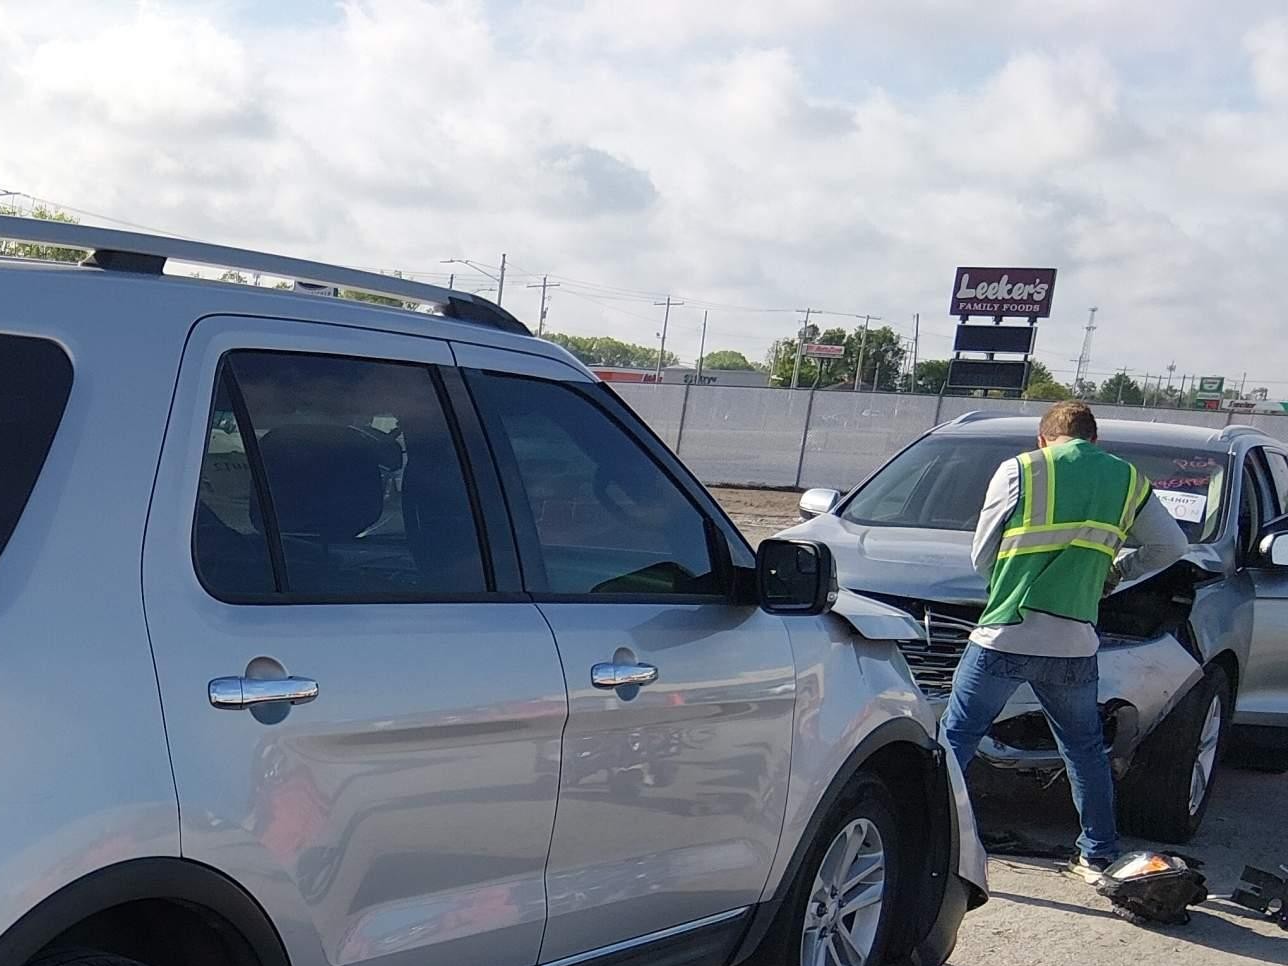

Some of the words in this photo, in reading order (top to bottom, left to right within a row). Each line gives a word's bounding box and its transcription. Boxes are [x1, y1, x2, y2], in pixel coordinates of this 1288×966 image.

[956, 273, 1049, 301] Leeker's
[959, 302, 1000, 311] FAMILY
[1002, 303, 1040, 312] FOODS
